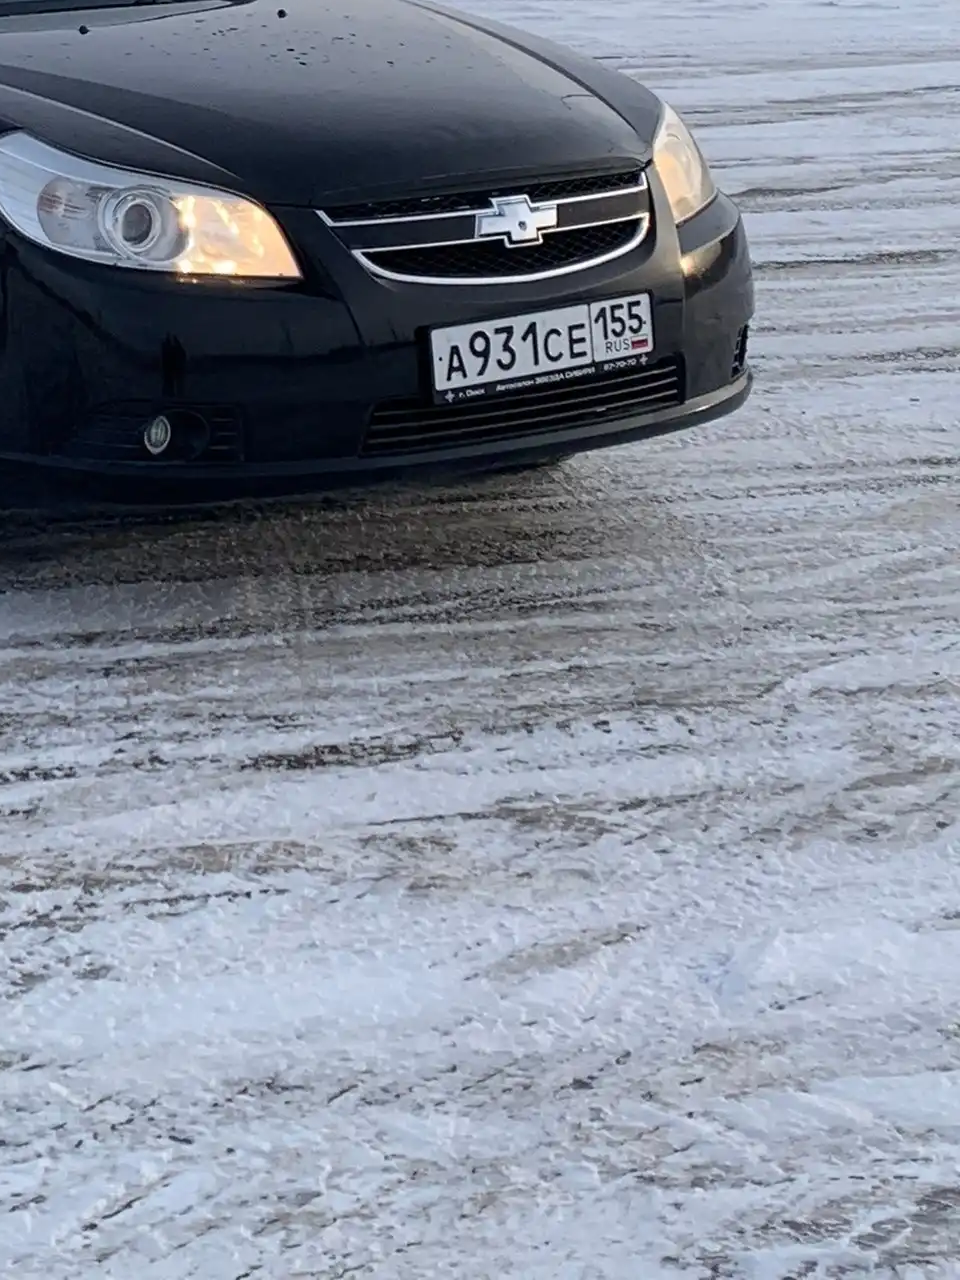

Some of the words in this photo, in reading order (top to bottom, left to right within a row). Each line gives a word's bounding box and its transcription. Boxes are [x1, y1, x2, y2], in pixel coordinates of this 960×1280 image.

[446, 321, 588, 382] А931СЕ
[594, 300, 642, 341] 155
[605, 339, 631, 354] RUS
